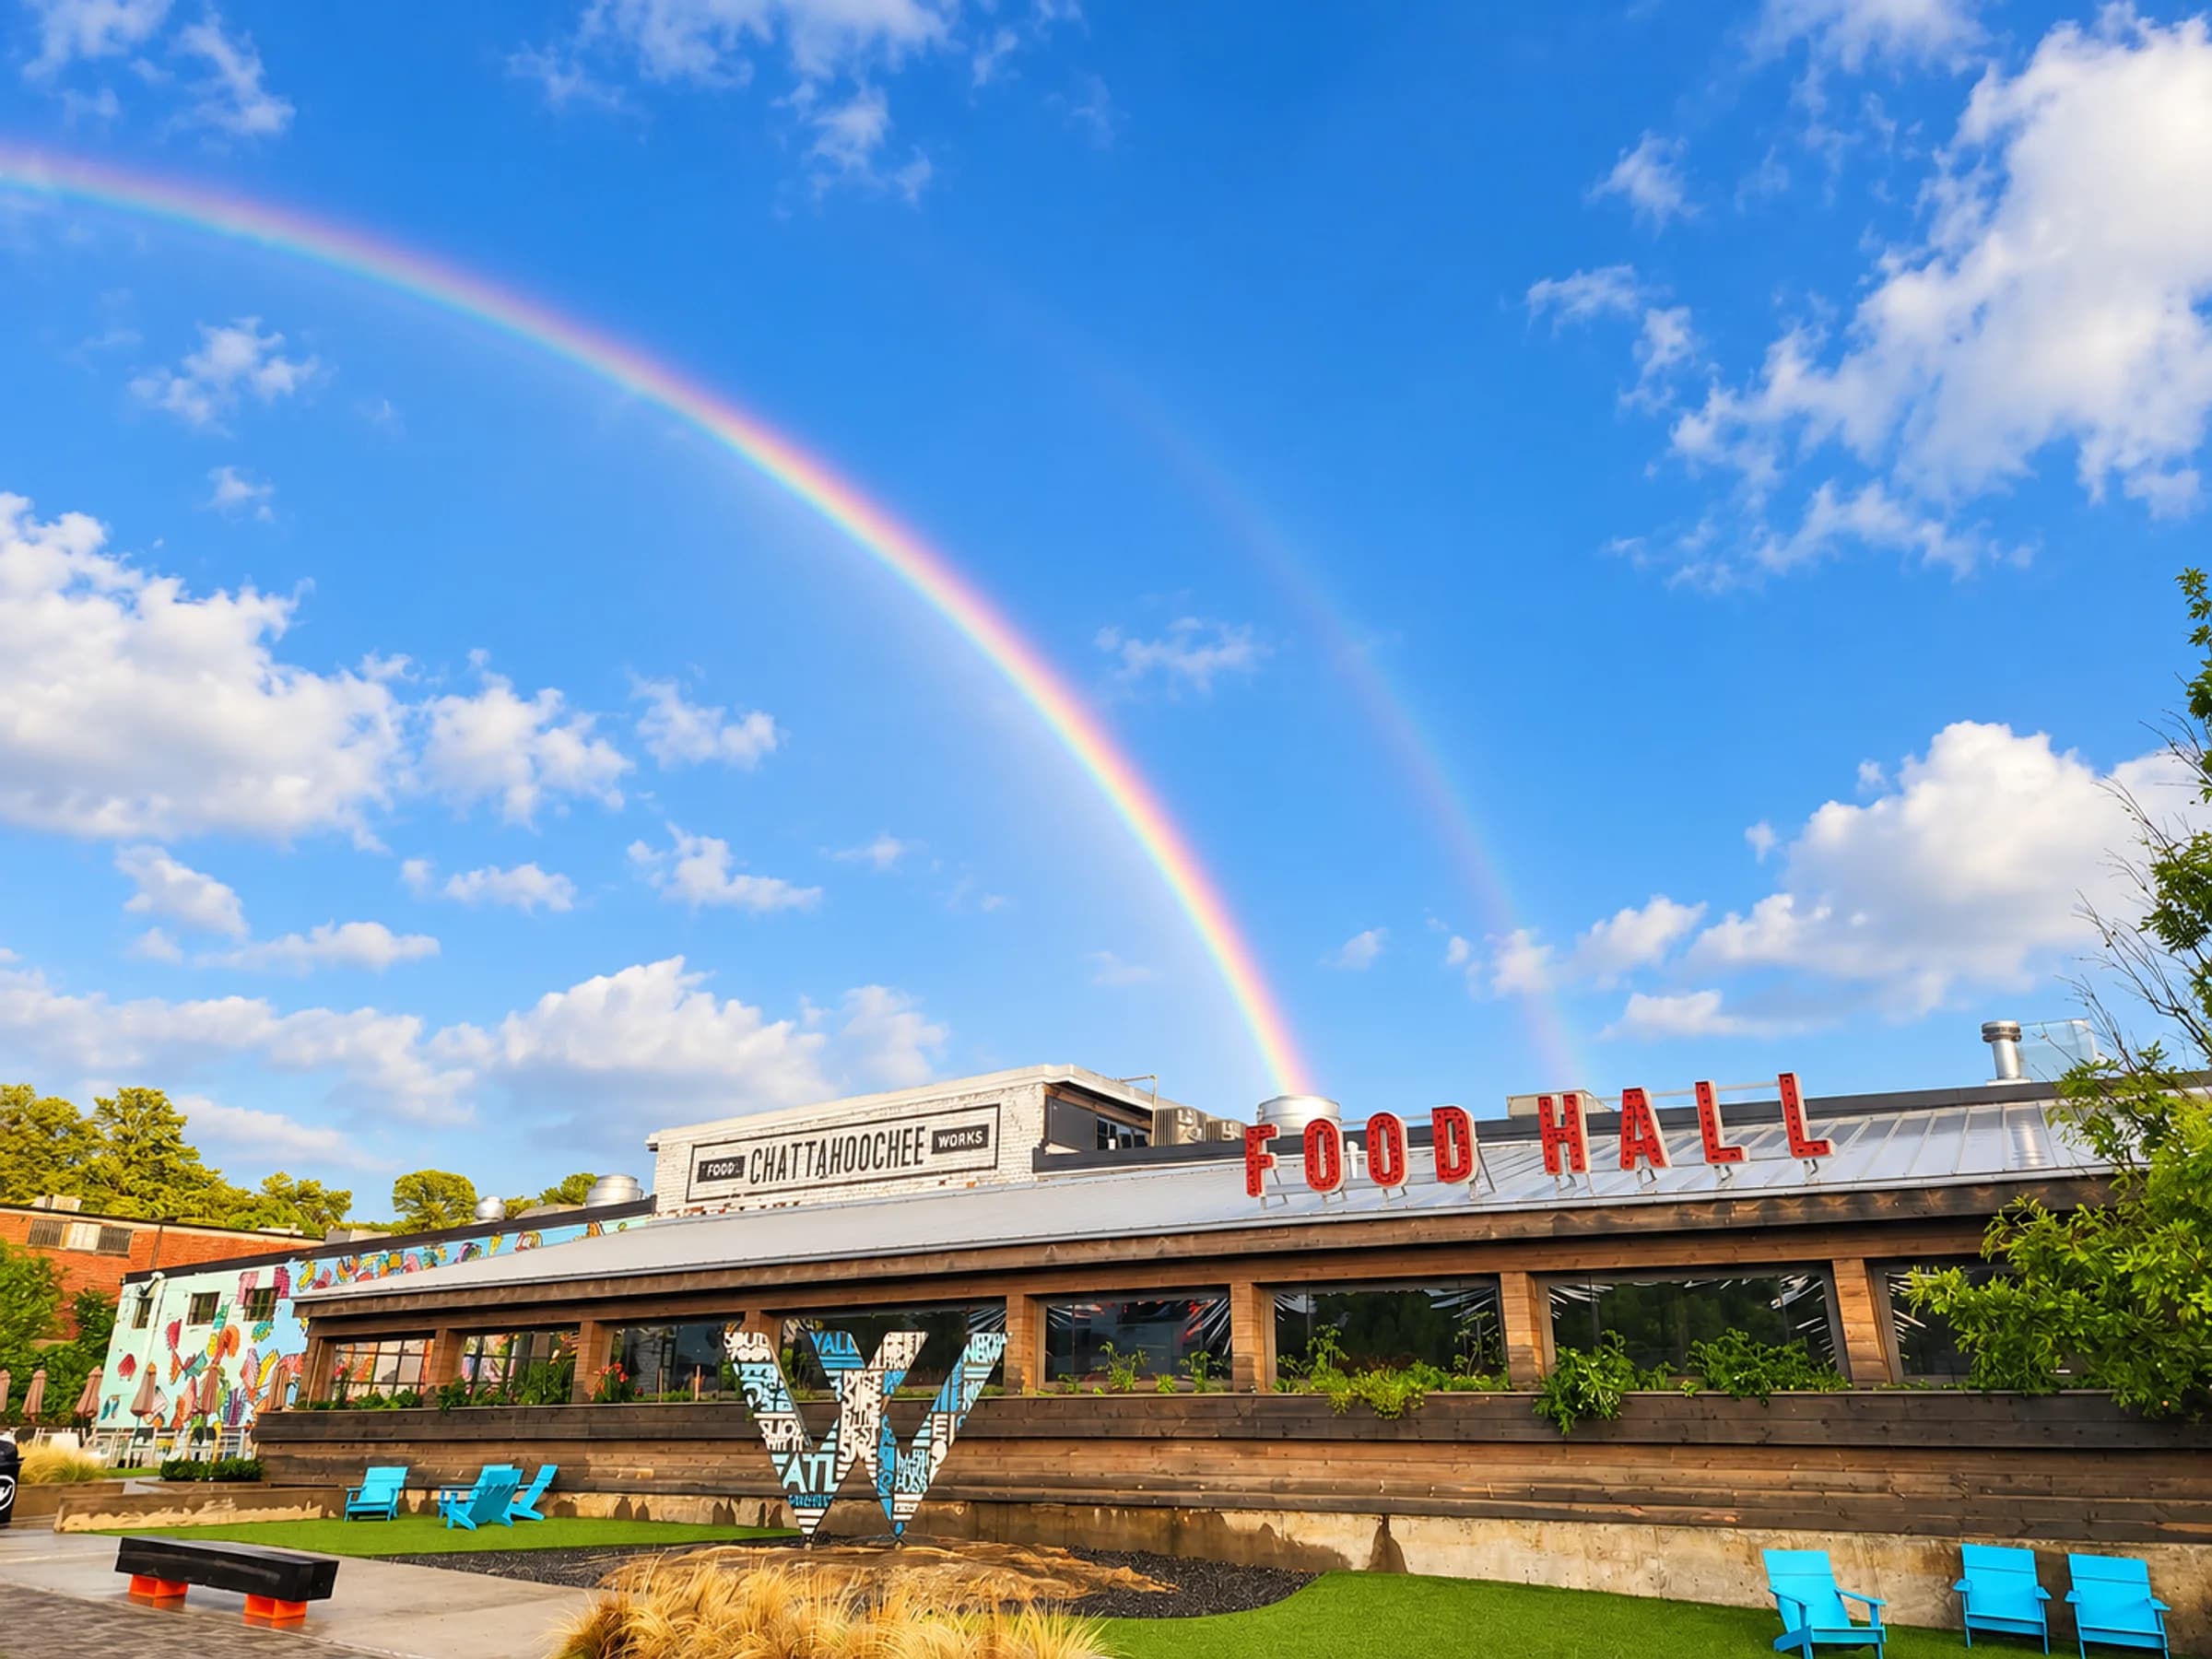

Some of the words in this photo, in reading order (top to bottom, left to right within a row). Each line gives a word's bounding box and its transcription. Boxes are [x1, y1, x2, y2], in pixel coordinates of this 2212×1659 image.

[706, 1161, 736, 1177] FOOD
[750, 1126, 925, 1184] CHATTAHOOCHEE
[937, 1130, 983, 1148] WORKS
[1244, 1105, 1477, 1198] FOOD
[1538, 1072, 1835, 1175] HALL
[782, 1452, 841, 1493] ATL
